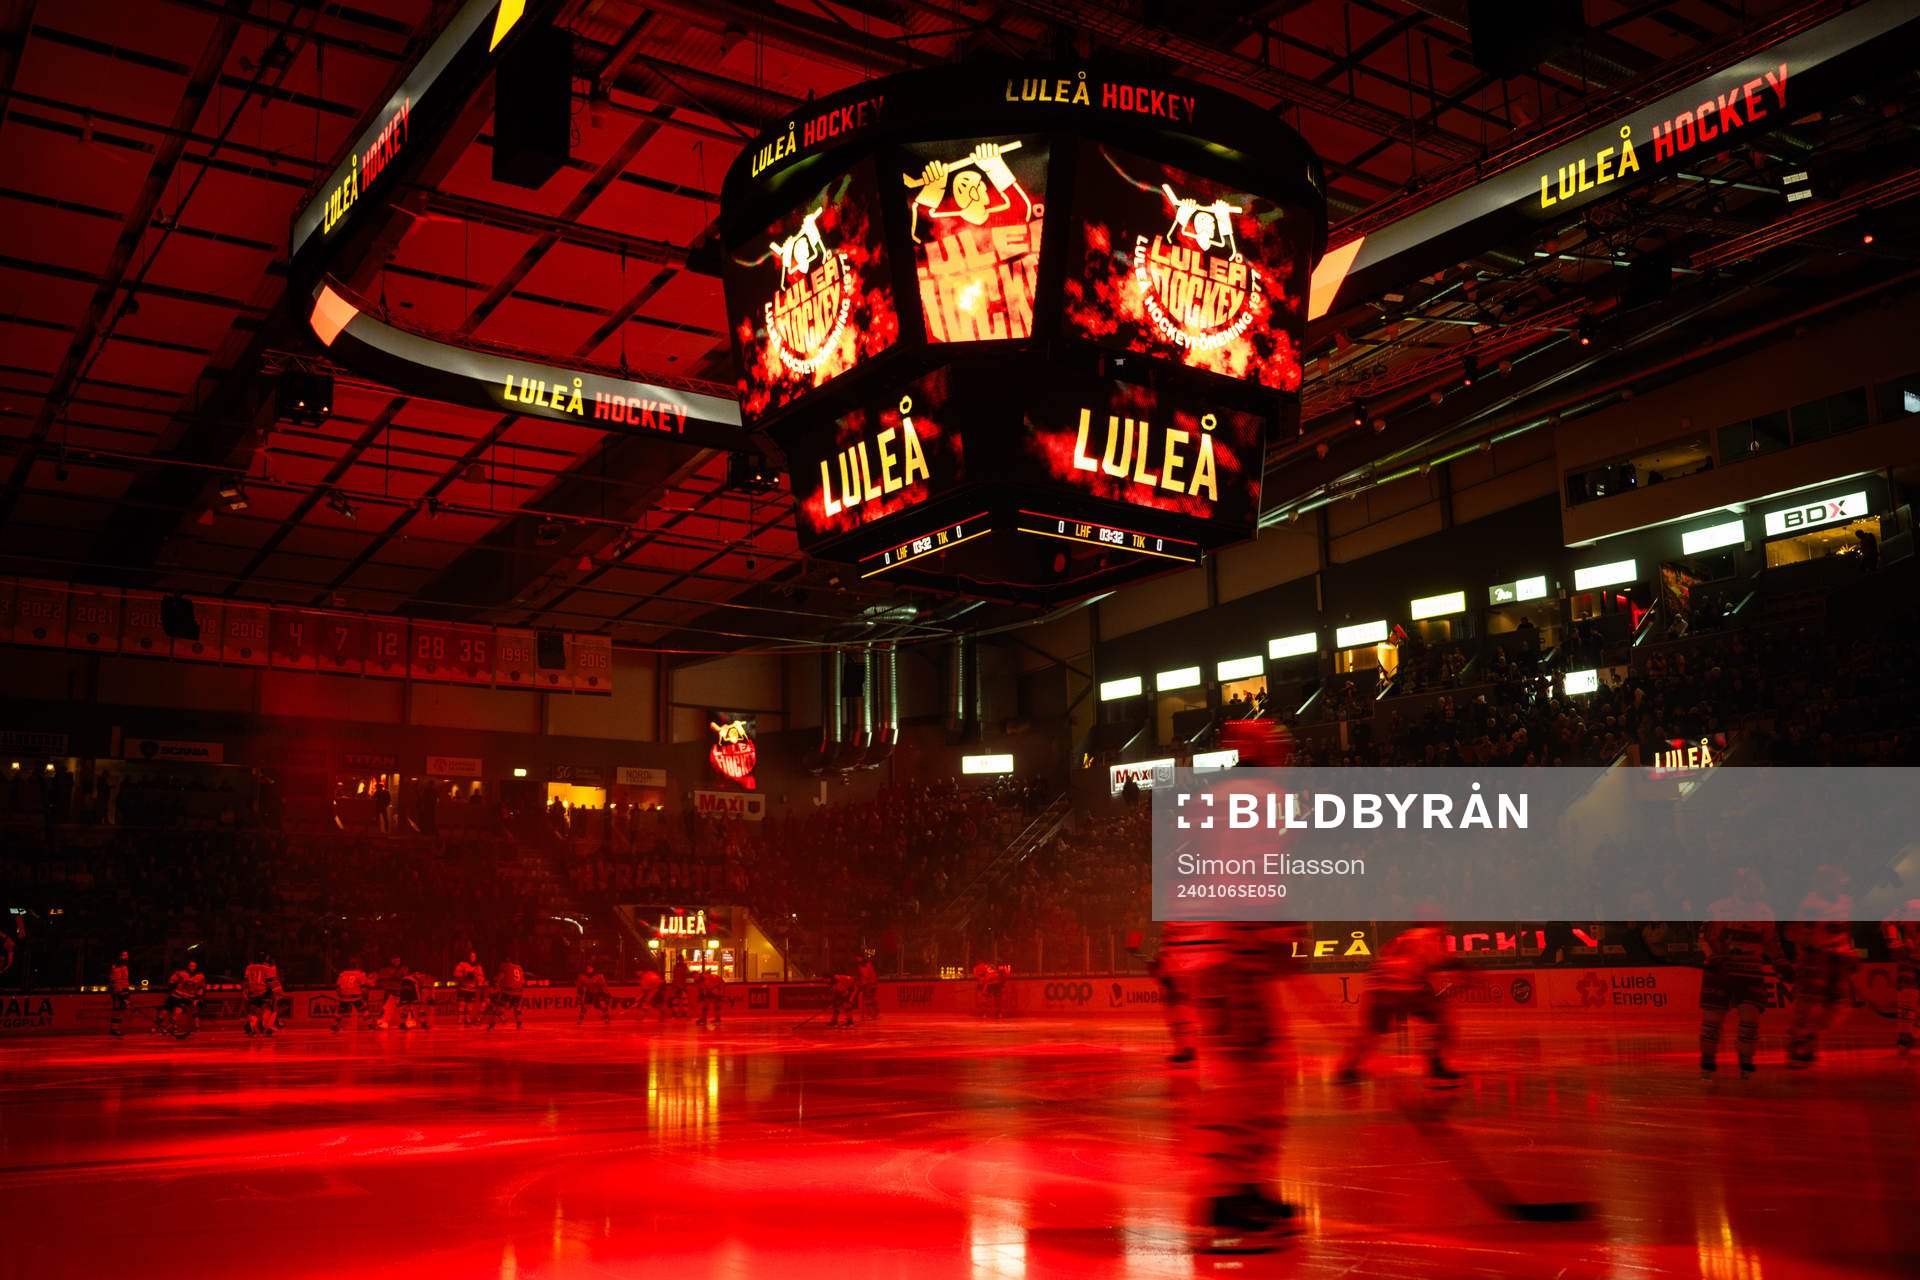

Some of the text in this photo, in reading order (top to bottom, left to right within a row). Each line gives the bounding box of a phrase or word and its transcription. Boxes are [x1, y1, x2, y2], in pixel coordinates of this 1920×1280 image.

[1005, 71, 1196, 124] LULEÅ HOCKEY
[752, 95, 885, 178] LULEÅ HOCKEY
[1541, 63, 1788, 209] LULEÅ HOCKEY
[324, 96, 410, 235] LULEÅ HOCKEY
[1150, 234, 1247, 289] LULEÅ
[773, 249, 840, 317] LULEÅ
[1150, 260, 1245, 329] HOCKEY
[774, 281, 841, 354] HOCKEY
[504, 374, 688, 434] LULEÅ HOCKEY
[820, 395, 930, 518] LULEÅ
[1073, 408, 1218, 502] LULEÅ
[1784, 500, 1847, 528] BDX
[896, 545, 908, 560] LHF
[937, 530, 948, 545] TIK
[1058, 520, 1163, 552] 0 LHF 03:32 TIK 0
[289, 623, 303, 647] 4
[335, 627, 348, 651] 7
[376, 631, 398, 656] 12
[418, 635, 445, 661] 28
[459, 639, 486, 663] 35
[1655, 738, 1713, 773] LULEÅ
[1115, 768, 1154, 784] MAXI
[700, 795, 745, 812] MAXI
[660, 910, 706, 935] LULEÅ
[1045, 982, 1093, 1005] coop
[1611, 974, 1656, 990] Luleå
[1612, 990, 1668, 1009] Energi
